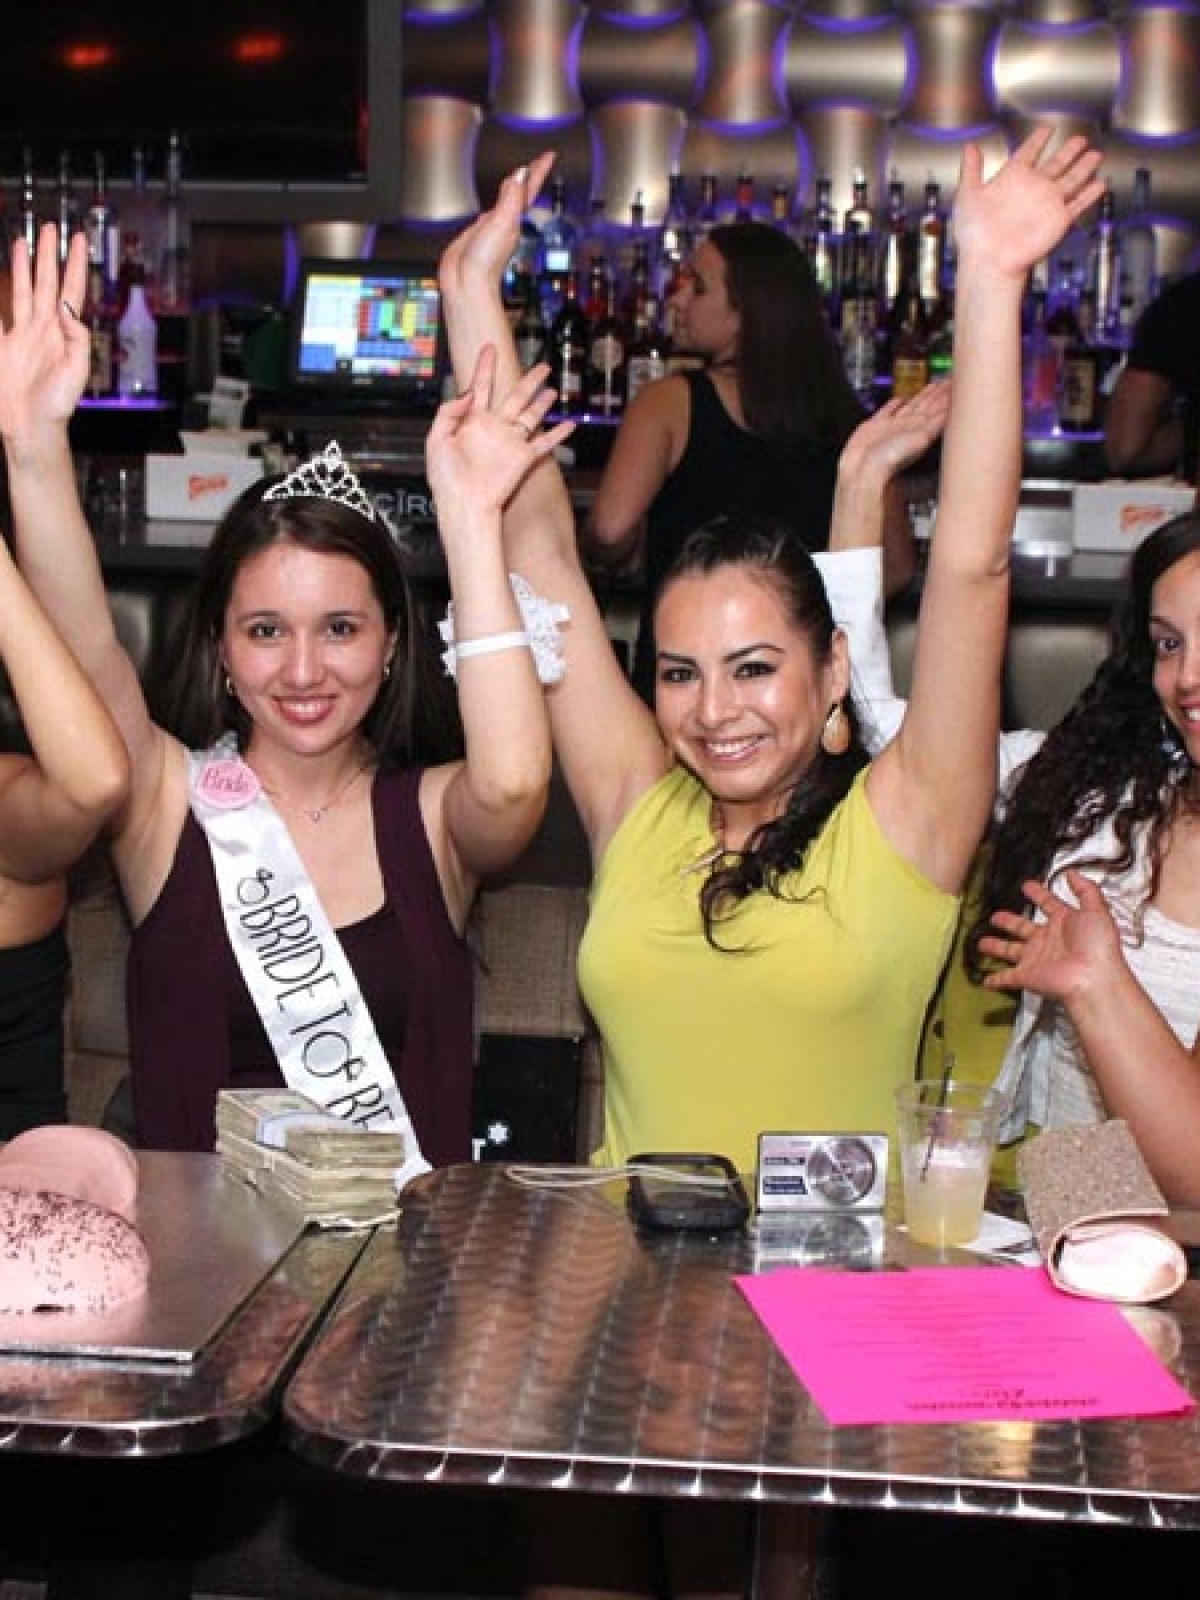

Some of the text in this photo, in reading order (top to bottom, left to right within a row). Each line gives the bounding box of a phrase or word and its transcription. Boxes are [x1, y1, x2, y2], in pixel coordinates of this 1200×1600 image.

[202, 766, 251, 793] Bride
[239, 892, 341, 1013] BRIDE
[289, 1000, 367, 1082] TO
